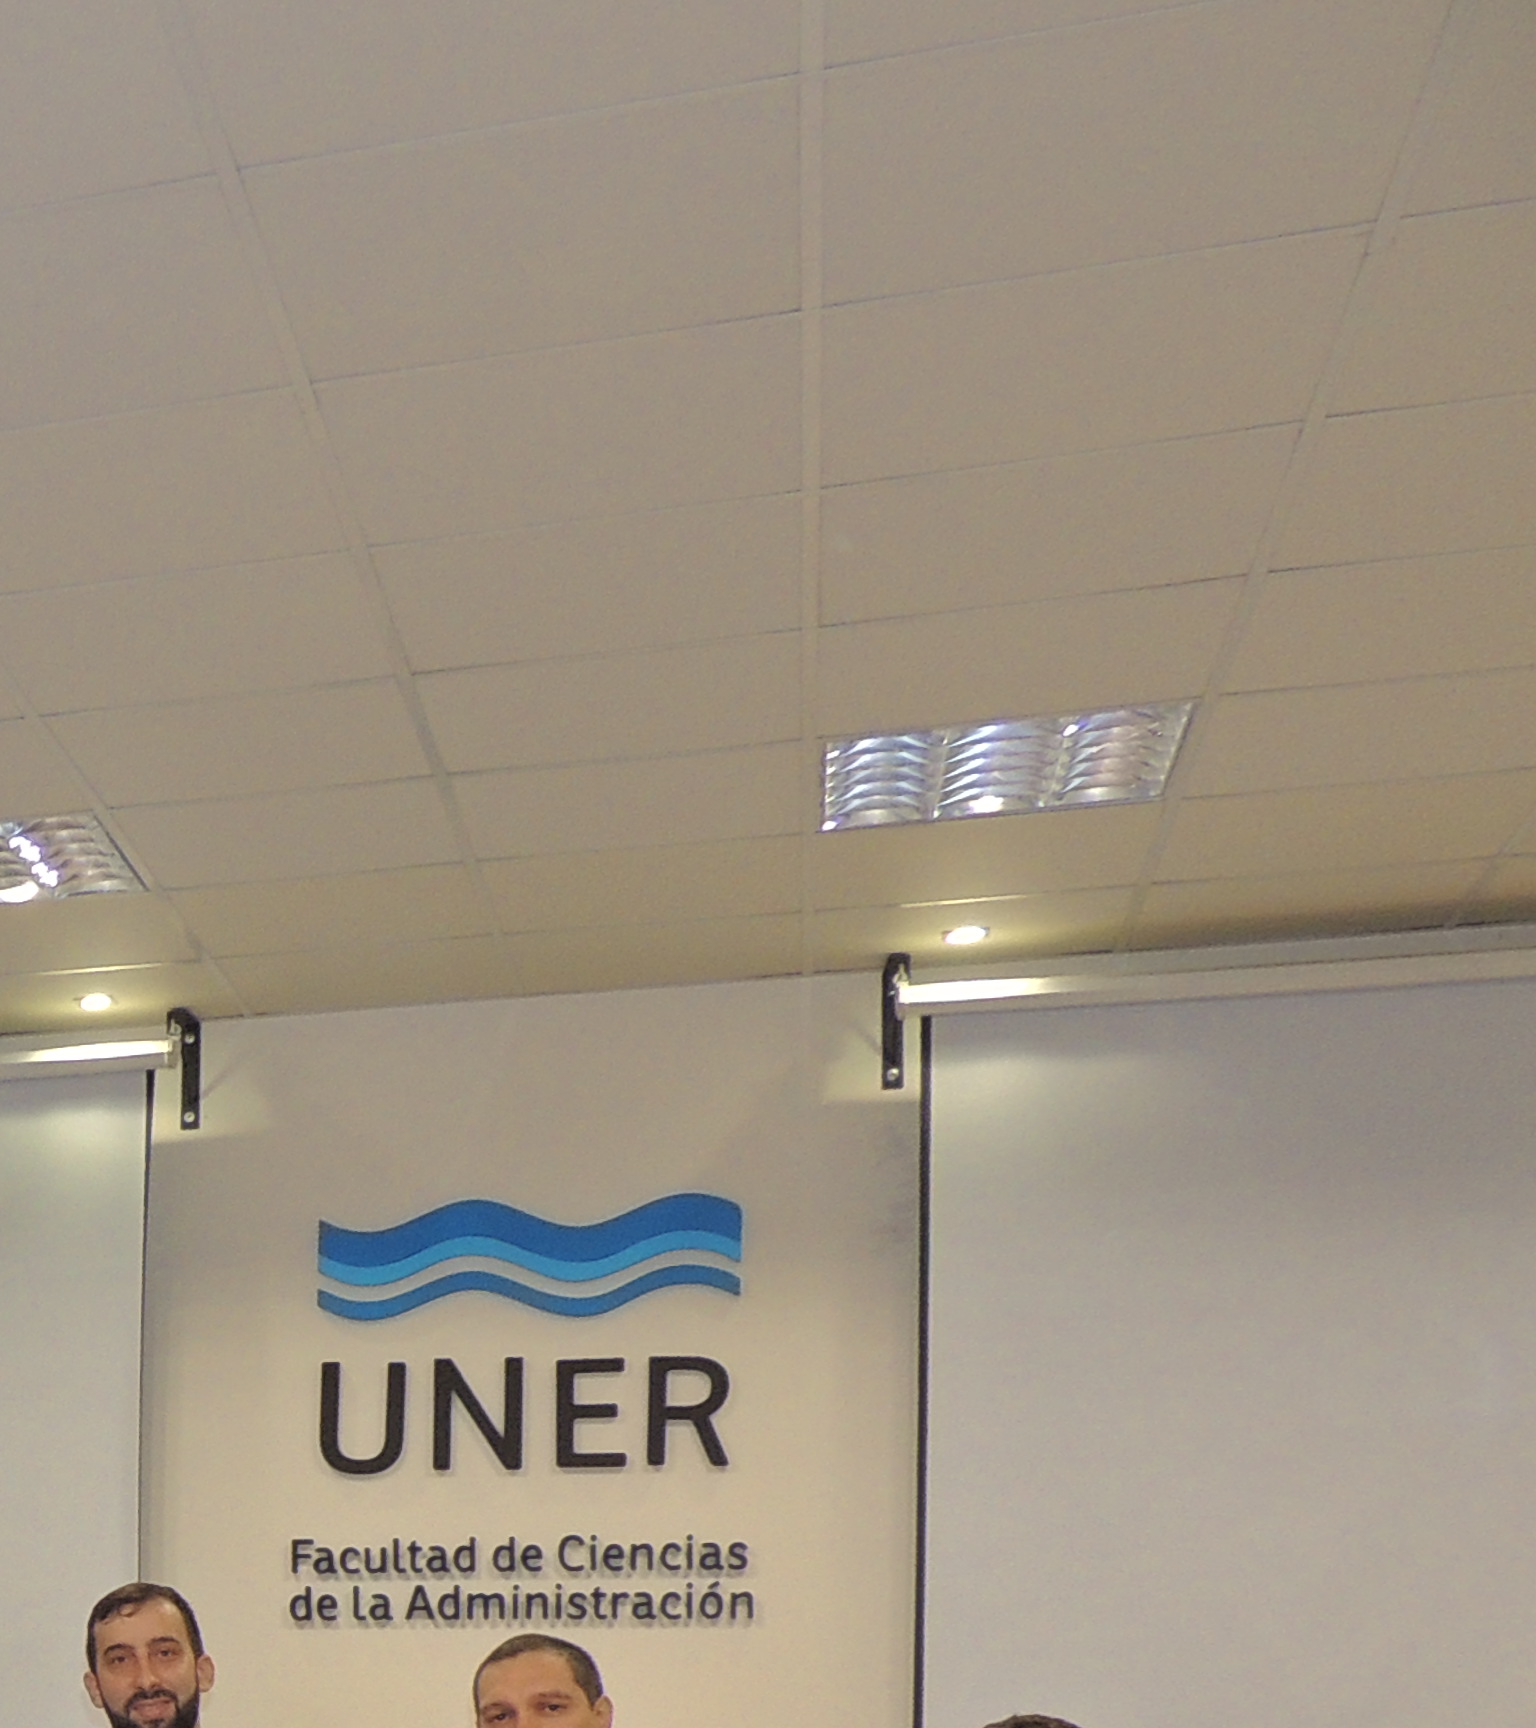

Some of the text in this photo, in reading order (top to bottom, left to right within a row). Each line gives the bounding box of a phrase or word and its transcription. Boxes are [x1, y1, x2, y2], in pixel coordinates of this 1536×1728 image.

[319, 1356, 730, 1475] UNER
[290, 1534, 749, 1574] Facultad de Ciencias
[289, 1581, 755, 1621] de la Administración
